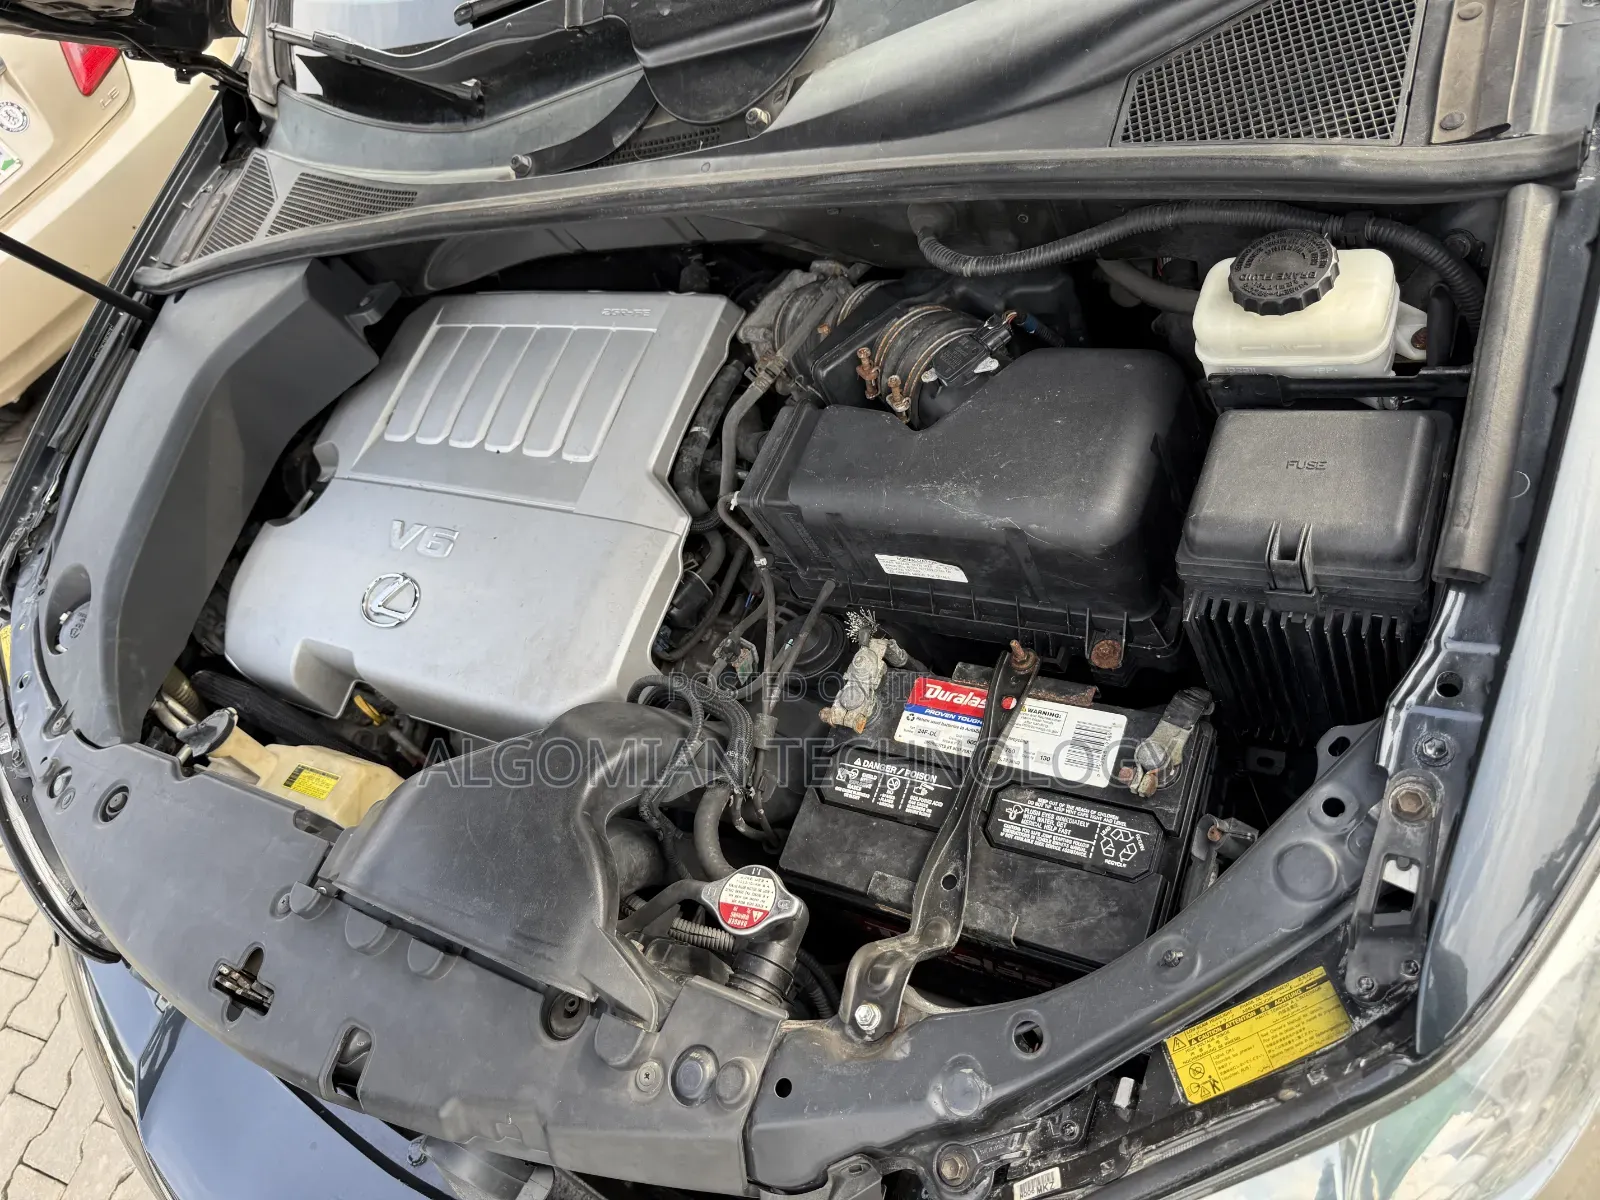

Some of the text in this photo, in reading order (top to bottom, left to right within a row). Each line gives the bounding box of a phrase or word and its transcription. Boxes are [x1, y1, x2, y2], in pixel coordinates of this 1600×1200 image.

[1285, 460, 1328, 471] FUSE
[389, 519, 460, 558] V6
[923, 684, 987, 708] Duralas
[924, 709, 955, 718] PROVEN
[1027, 708, 1061, 718] WARNING:
[862, 760, 896, 772] DANGER
[904, 769, 936, 782] POISON
[1021, 819, 1042, 827] MEDICAL
[1055, 815, 1089, 827] IMMEDIATELY
[1273, 989, 1302, 1005] ACHTUNG
[1197, 1026, 1222, 1041] CAUTION
[1224, 1010, 1256, 1028] ATTENTION
